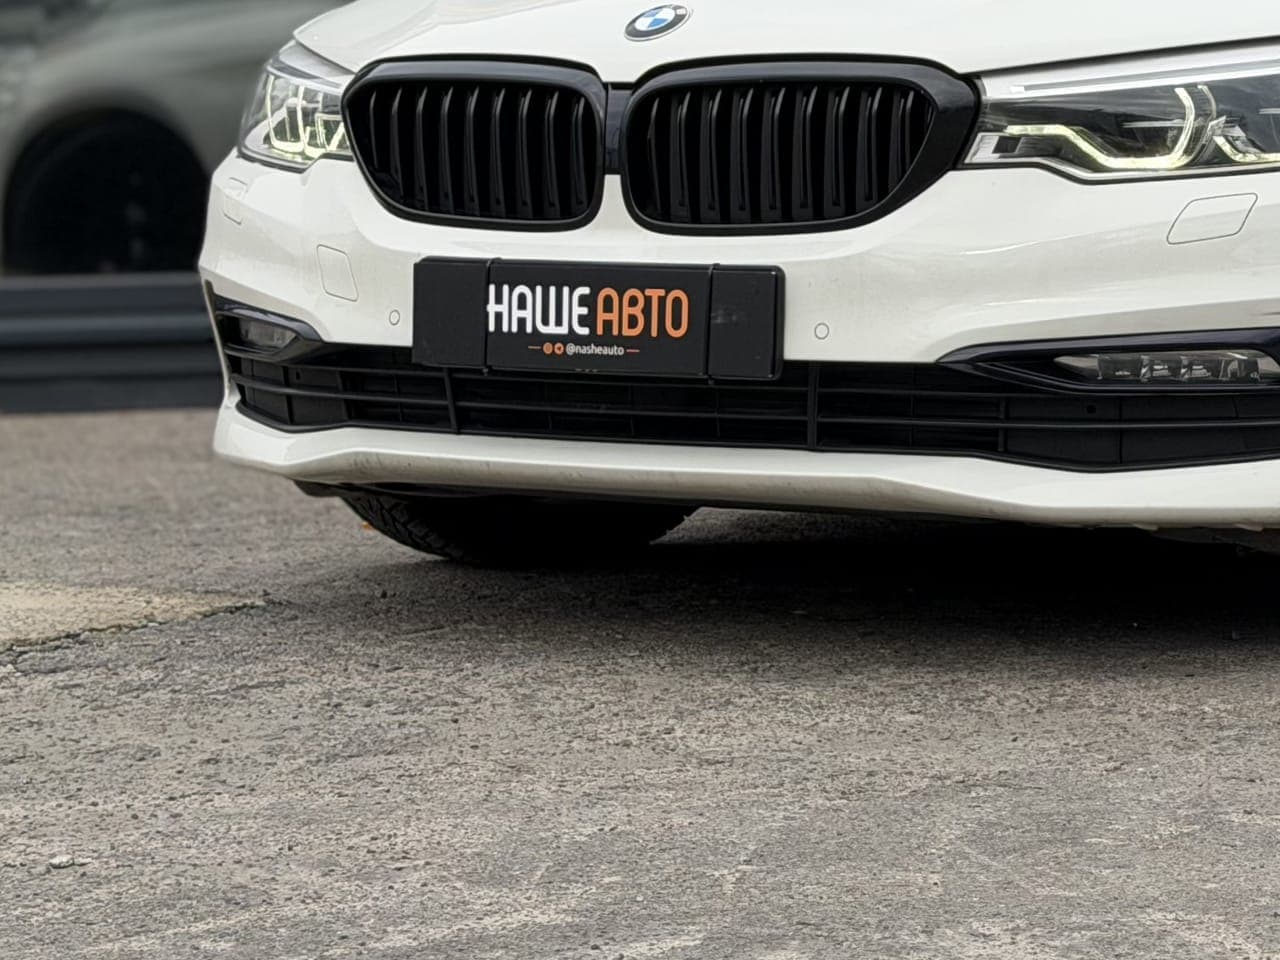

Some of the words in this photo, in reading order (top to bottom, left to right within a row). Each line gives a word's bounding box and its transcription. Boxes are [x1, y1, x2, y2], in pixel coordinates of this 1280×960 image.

[486, 283, 591, 336] НАШЕ
[596, 286, 690, 338] АВТО
[565, 342, 625, 356] @nasheauto
